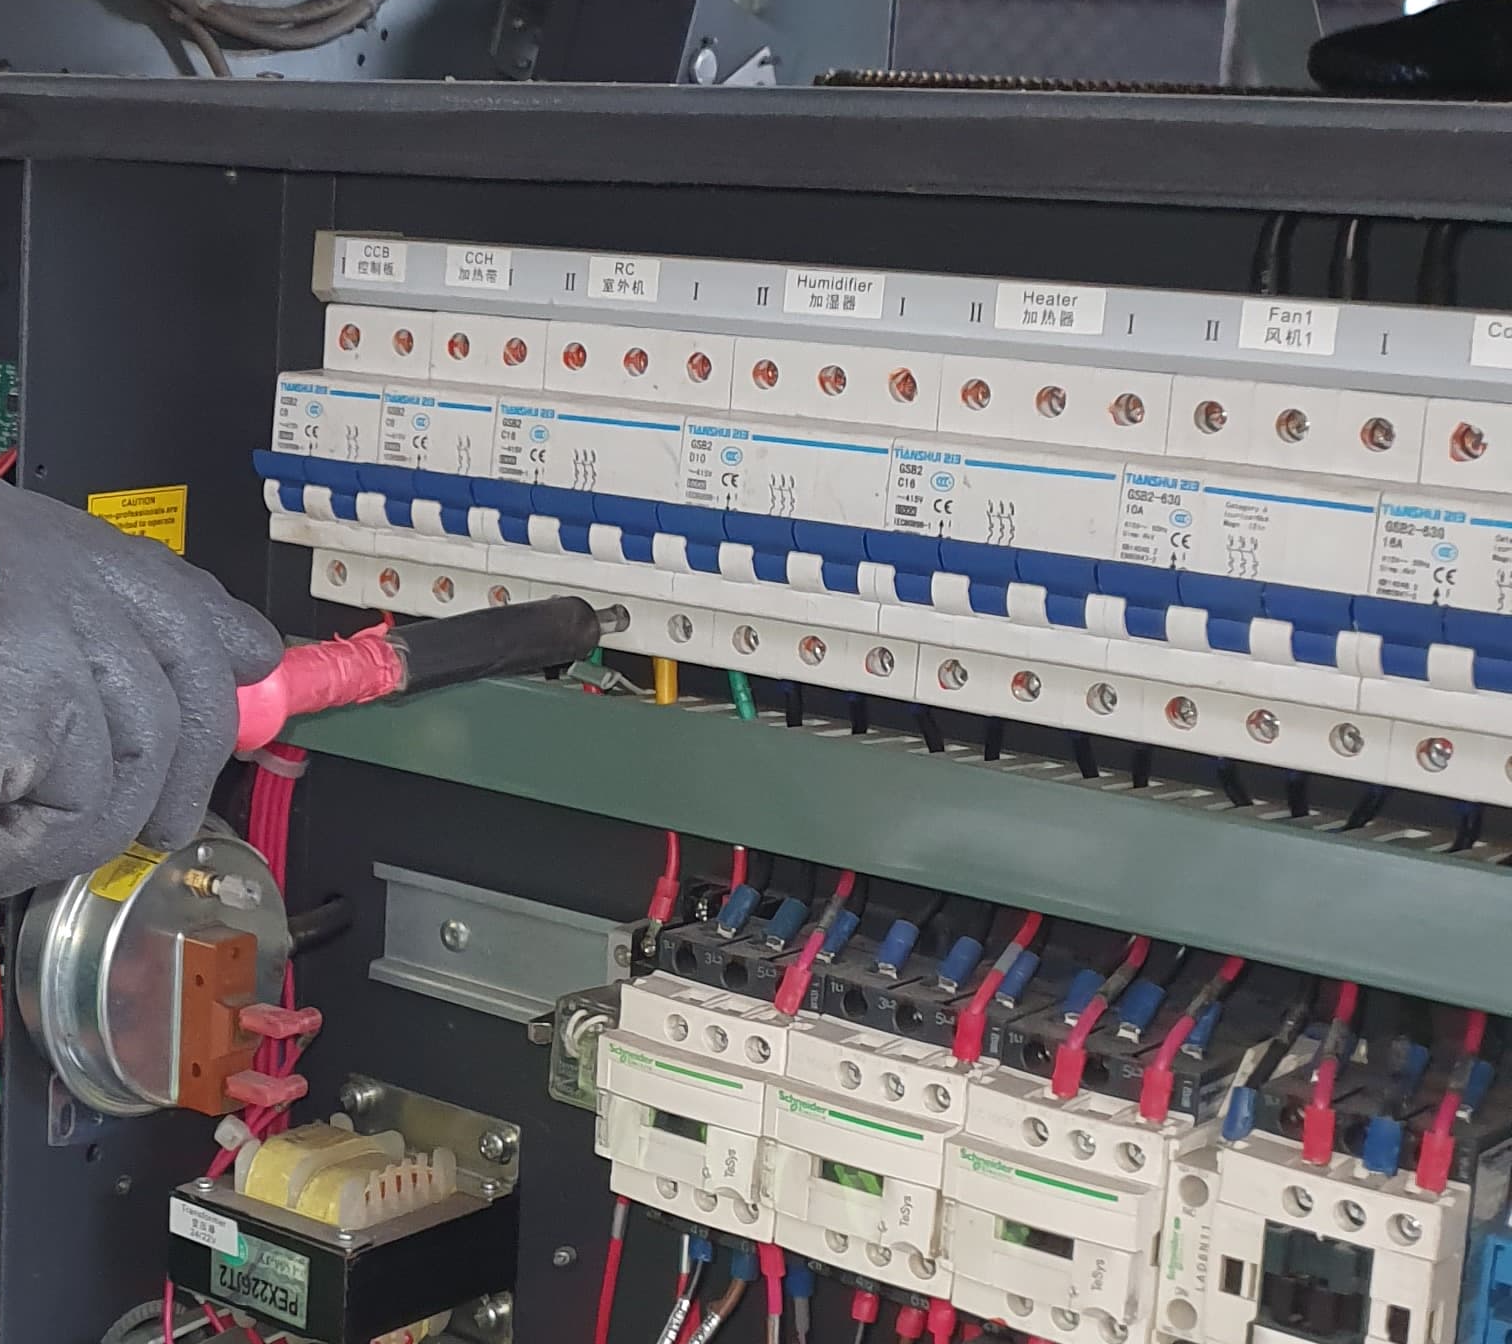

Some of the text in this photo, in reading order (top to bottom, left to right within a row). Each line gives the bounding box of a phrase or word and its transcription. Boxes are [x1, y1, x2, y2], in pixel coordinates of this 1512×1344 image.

[363, 244, 391, 259] CCB
[464, 251, 495, 266] CCH
[613, 261, 636, 277] RC
[601, 278, 646, 296] 室外机
[796, 274, 874, 293] Humidifier
[808, 293, 857, 312] 加湿器
[1022, 290, 1079, 308] Heater
[1021, 309, 1075, 328] 加热器
[1267, 306, 1313, 326] Fan1
[690, 438, 713, 452] GSB2
[893, 447, 942, 463] TIANSHUI
[899, 463, 924, 476] GSB2
[1126, 471, 1178, 490] TIANSHUI
[121, 496, 156, 507] CAUTION
[1125, 504, 1144, 516] 10A
[608, 1042, 654, 1064] Schneider
[778, 1089, 828, 1112] Schneider
[723, 1147, 737, 1178] TeSys
[959, 1146, 1014, 1173] Schneider
[899, 1194, 913, 1227] TeSys
[1090, 1258, 1106, 1292] TeSys
